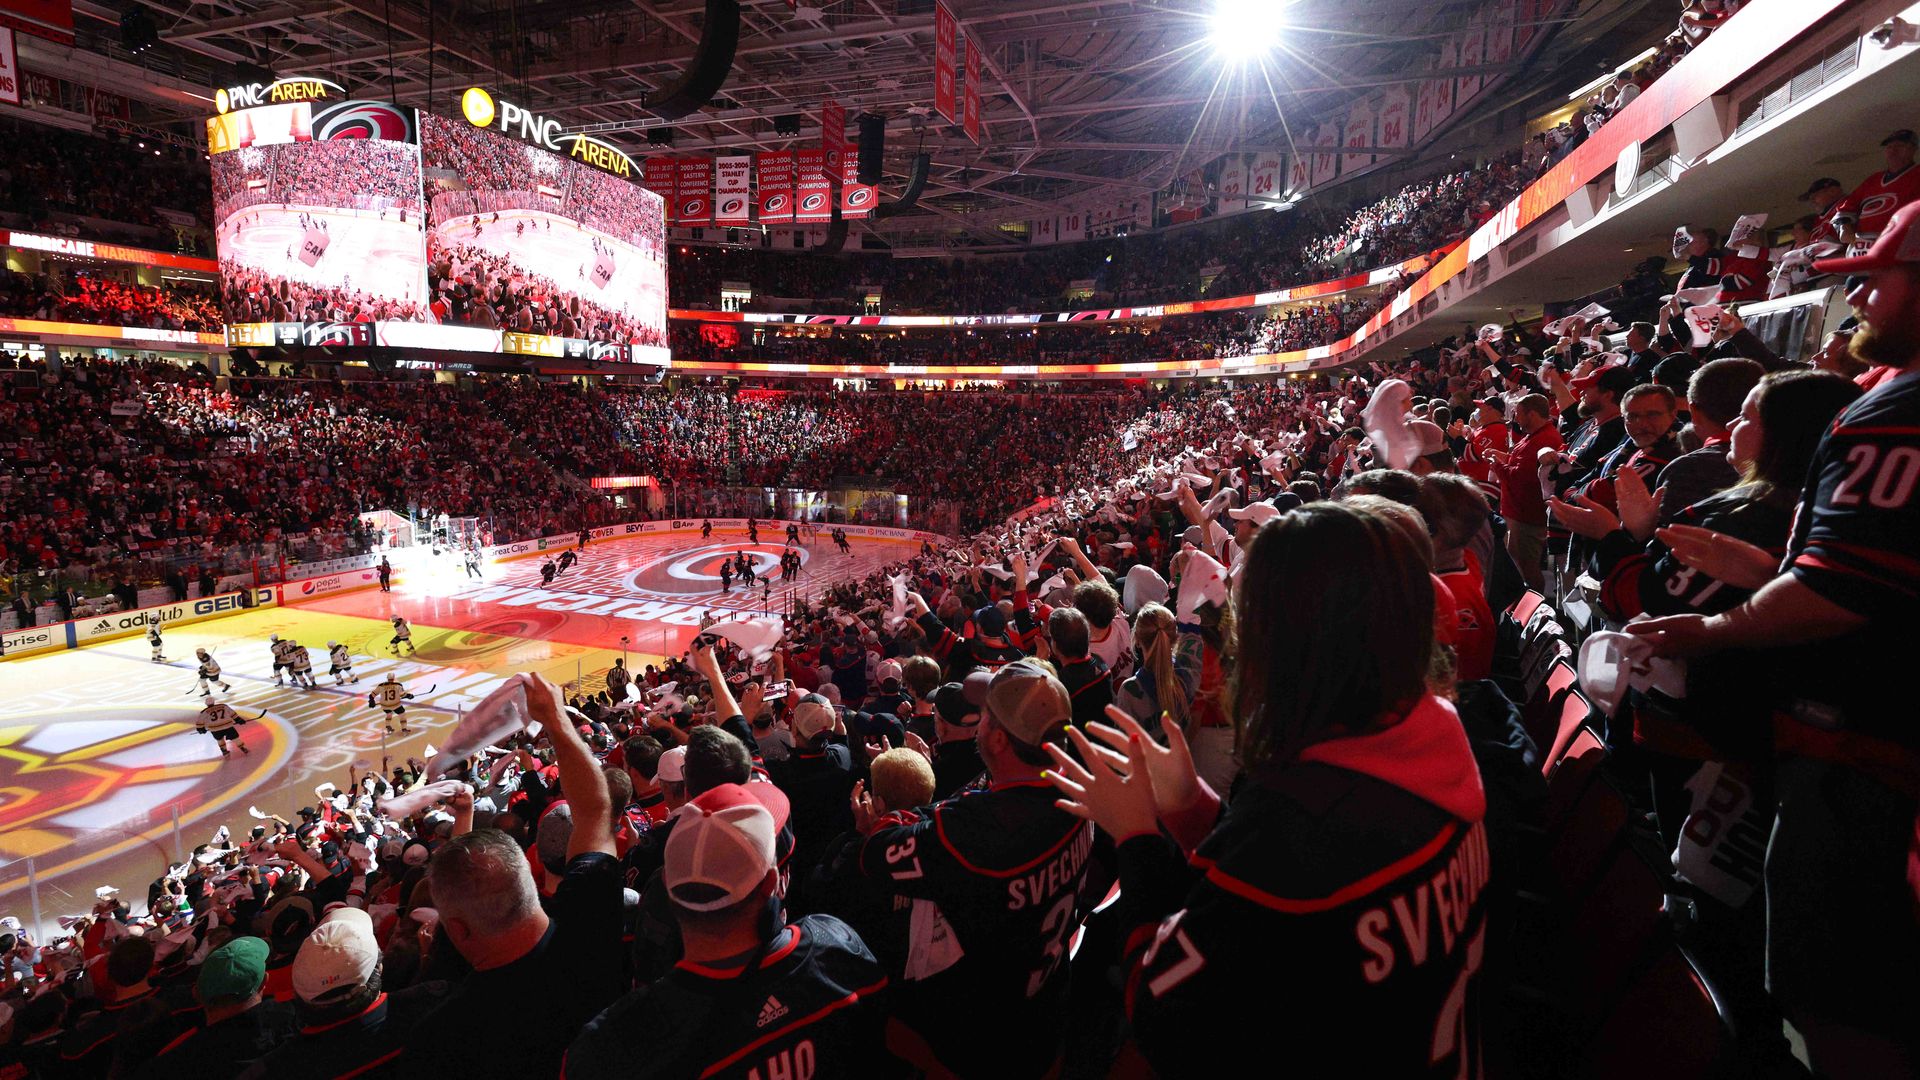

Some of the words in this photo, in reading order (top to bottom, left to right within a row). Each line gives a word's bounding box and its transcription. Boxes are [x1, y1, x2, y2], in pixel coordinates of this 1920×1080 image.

[228, 83, 264, 109] PNC
[271, 81, 327, 102] ARENA
[500, 100, 562, 151] PNC
[571, 133, 630, 177] ARENA
[680, 163, 709, 171] 2005-2006
[760, 157, 791, 165] 2005-2006
[760, 165, 791, 174] SOUTHEAST
[763, 174, 787, 182] DIVISION
[1255, 173, 1272, 194] 24
[760, 183, 791, 191] CHAMPIONS
[1038, 219, 1050, 235] 14
[1065, 215, 1078, 231] 10
[1164, 302, 1193, 315] WARNING
[1831, 443, 1920, 509] 20
[626, 524, 644, 534] BEVY
[510, 544, 528, 553] Clips
[316, 576, 340, 588] pepsi
[91, 627, 115, 635] adidas
[384, 689, 396, 701] 13
[210, 709, 225, 722] 37
[885, 836, 924, 881] 37
[756, 1005, 790, 1028] adidas
